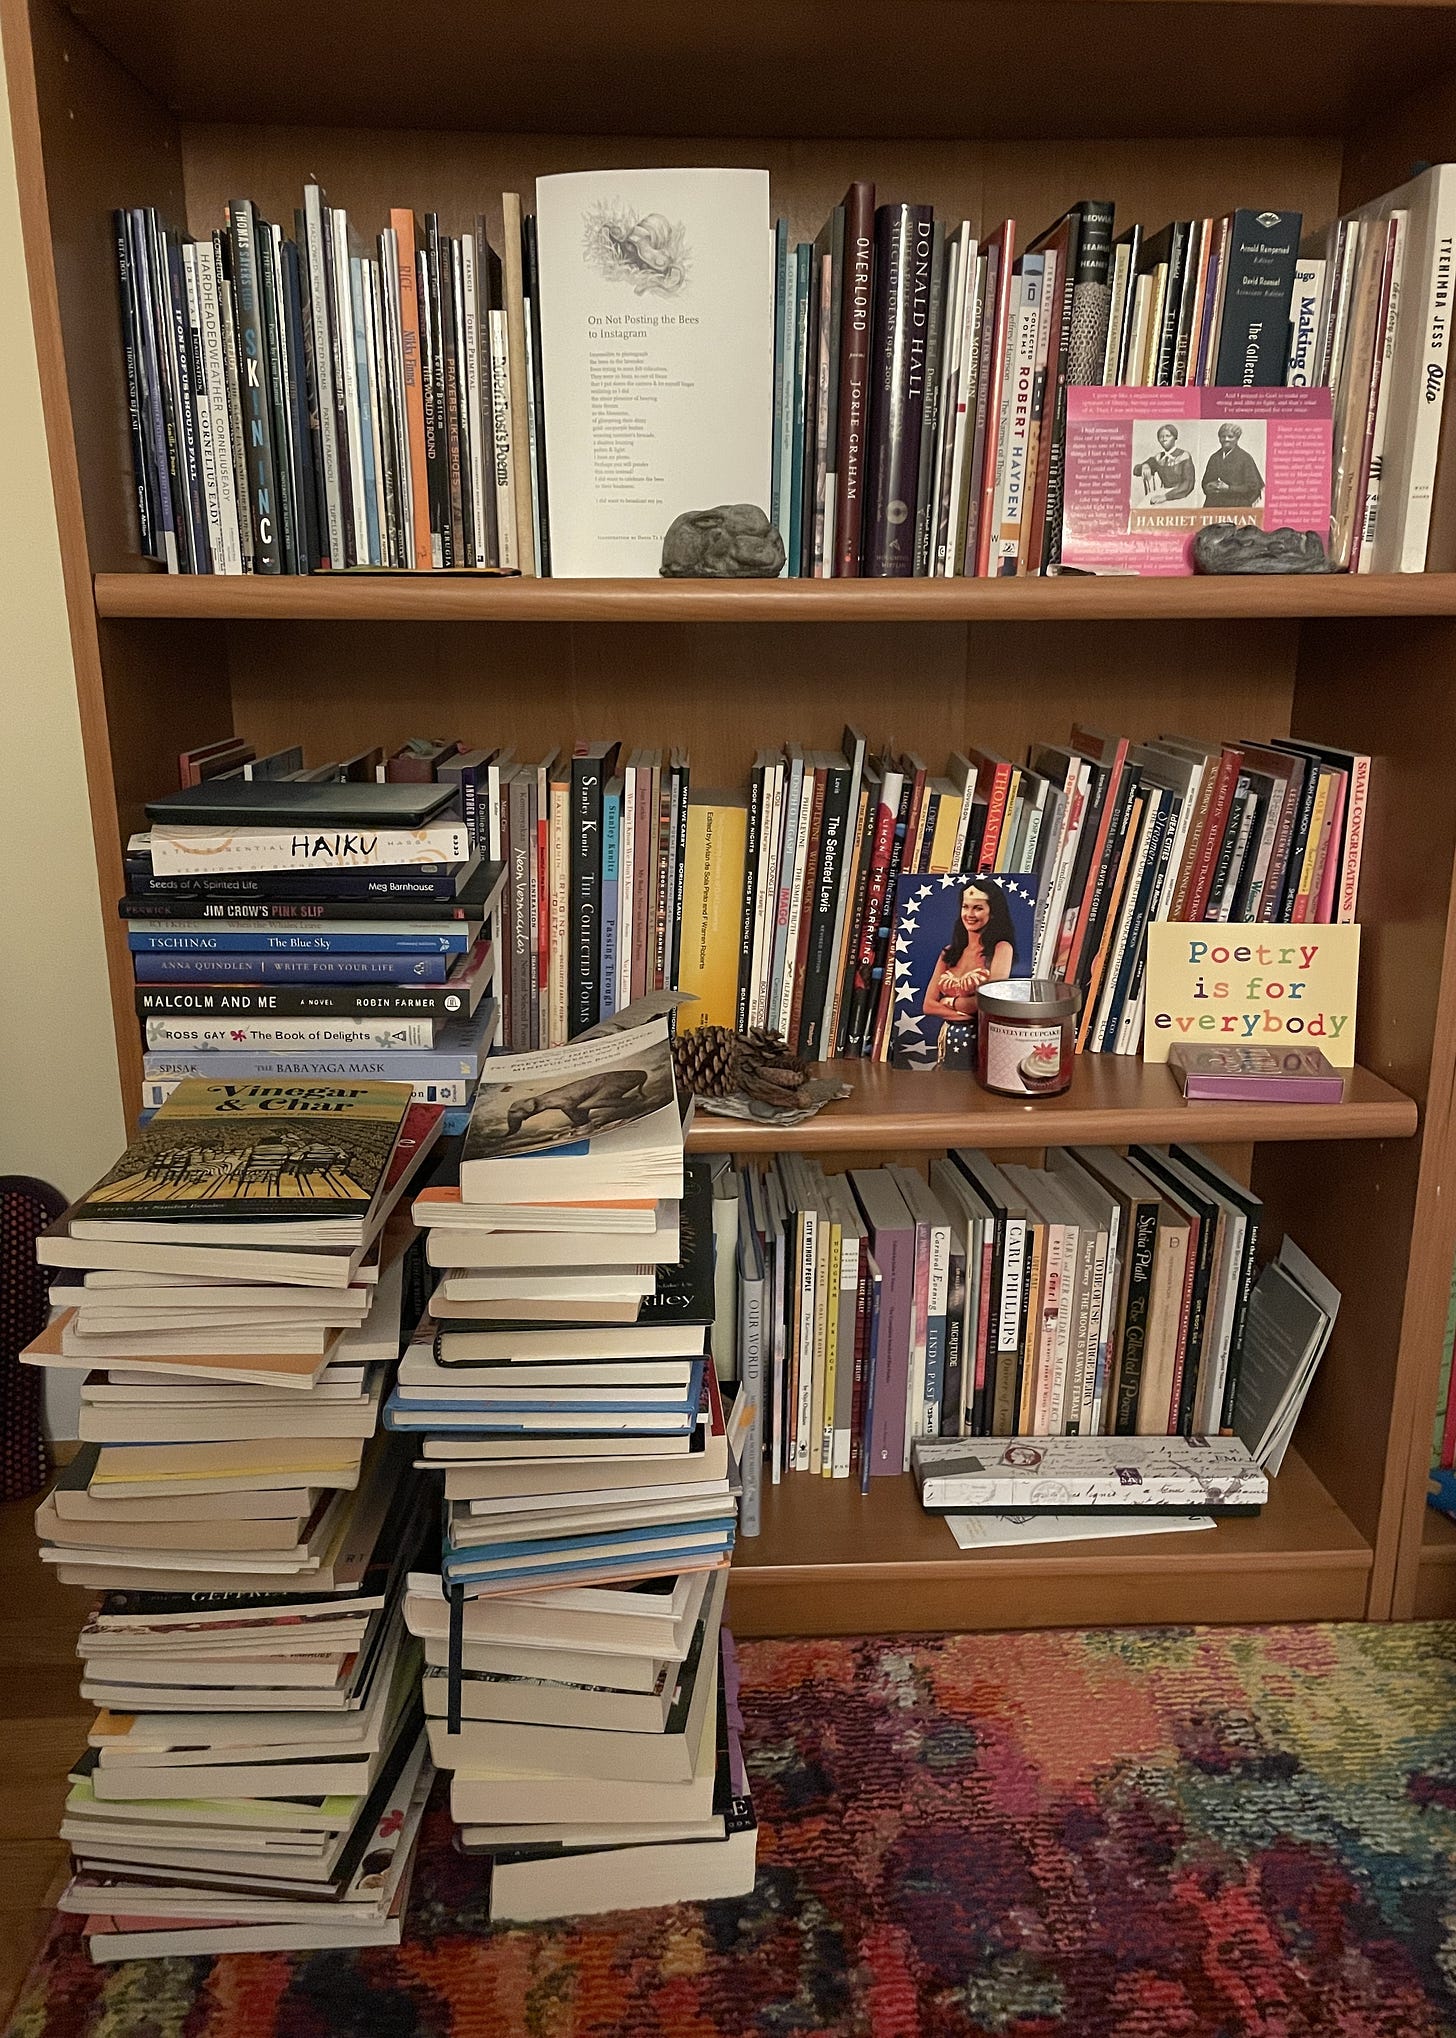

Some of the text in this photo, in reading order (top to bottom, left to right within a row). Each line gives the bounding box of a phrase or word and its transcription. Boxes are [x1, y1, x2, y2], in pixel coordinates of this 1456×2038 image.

[889, 220, 901, 286] SELECTED
[400, 265, 412, 292] RICE
[852, 236, 871, 332] OVERLORD
[1242, 275, 1259, 286] David
[1430, 237, 1453, 350] TYEHIMBA JESS
[587, 314, 700, 327] On Not Posting the Bees
[886, 288, 898, 334] POEMS
[908, 221, 931, 400] DONALD HALL
[1059, 276, 1075, 352] TERRANCE HAYES
[1290, 297, 1316, 368] Making
[403, 330, 416, 356] Nikky
[467, 313, 478, 391] FOREST PRIMEVAL
[588, 329, 648, 341] to Instagram
[1003, 313, 1017, 381] Jeffrey Harrison
[1021, 316, 1030, 356] POEMS
[1027, 312, 1037, 360] COLLECTED
[404, 358, 418, 388] Finney
[882, 364, 893, 392] 2006
[1425, 362, 1445, 405] Olio
[323, 407, 332, 441] PATRICIA
[447, 358, 462, 486] PRAYERS LIKE SHOES
[492, 356, 510, 488] Robert Frost's Poems
[846, 379, 861, 501] JORIE GRAHAM
[1007, 366, 1032, 518] ROBERT HAYDEN
[201, 410, 219, 527] CORNELIUS EADY
[330, 504, 341, 562] TUPELO PRESS
[1136, 515, 1196, 529] HARRIET
[443, 524, 454, 568] PERUGIA
[464, 784, 476, 815] ANOTHER
[833, 777, 842, 794] Levis
[961, 784, 975, 822] LUDVIGSON
[579, 776, 599, 858] Stanley Kunitz
[797, 796, 810, 849] PHILIP LEVINE
[811, 783, 825, 842] PHILIP LEVINE
[925, 805, 938, 833] LORDE
[983, 769, 1010, 861] THOMAS LUX
[1343, 761, 1367, 911] SMALL CONGREGATIONS
[291, 834, 378, 858] HAIKU
[606, 804, 618, 873] Stanley Kunitz
[953, 832, 966, 867] Escaping
[1147, 810, 1168, 866] Streamers
[1188, 820, 1204, 860] SELECTED
[1213, 804, 1243, 898] ANNE MICHAELS
[368, 882, 435, 893] Meg Barnhouse
[513, 847, 529, 882] Neon
[676, 862, 685, 901] DORIANNE
[818, 816, 841, 913] The Selected Levis
[1188, 823, 1218, 922] SELECTED TRANSLATIONS
[203, 904, 326, 918] JIM CROW'S PINK SLIP
[529, 878, 538, 929] GENERATION
[558, 874, 567, 937] BRINGING
[777, 887, 791, 926] IMAGO
[1171, 860, 1198, 918] TRANSLATIONS
[515, 882, 531, 955] Vernacular
[859, 866, 885, 966] THE CARRYING
[1129, 912, 1143, 949] McPHERSON
[148, 937, 218, 949] TSCHINAG
[161, 961, 254, 972] ANNA QUINDLEN
[267, 937, 332, 951] The Blue Sky
[603, 919, 616, 1007] Passing Through
[1187, 940, 1320, 970] Poetry
[273, 962, 395, 972] WRITE FOR YOUR LIFE
[1193, 976, 1307, 1000] is for
[143, 994, 279, 1009] MALCOLM AND ME
[355, 998, 437, 1008] ROBIN FARMER
[1153, 1008, 1351, 1039] everybody
[165, 1030, 227, 1041] ROSS GAY
[249, 1029, 372, 1046] The Book of Delights
[158, 1063, 200, 1073] SPISAK
[206, 1083, 370, 1101] Vinegar
[804, 1220, 815, 1293] CITY WITHOUT PEOPLE
[831, 1241, 840, 1298] HOLOGRAM
[928, 1230, 946, 1312] Carnival Evening
[1081, 1240, 1096, 1286] Marge Piercy
[1133, 1214, 1156, 1283] Sylvia Plath
[1002, 1225, 1023, 1346] CARL PHILLIPS
[1022, 1255, 1032, 1313] CARL PHILLIPS
[747, 1298, 762, 1329] OUR
[747, 1332, 761, 1380] WORLD
[948, 1320, 961, 1367] MIGRITUDE
[1118, 1296, 1146, 1426] The Collected Poems
[1050, 1357, 1065, 1424] MARGE PIERCY
[1083, 1332, 1098, 1408] MARGE PIERCY
